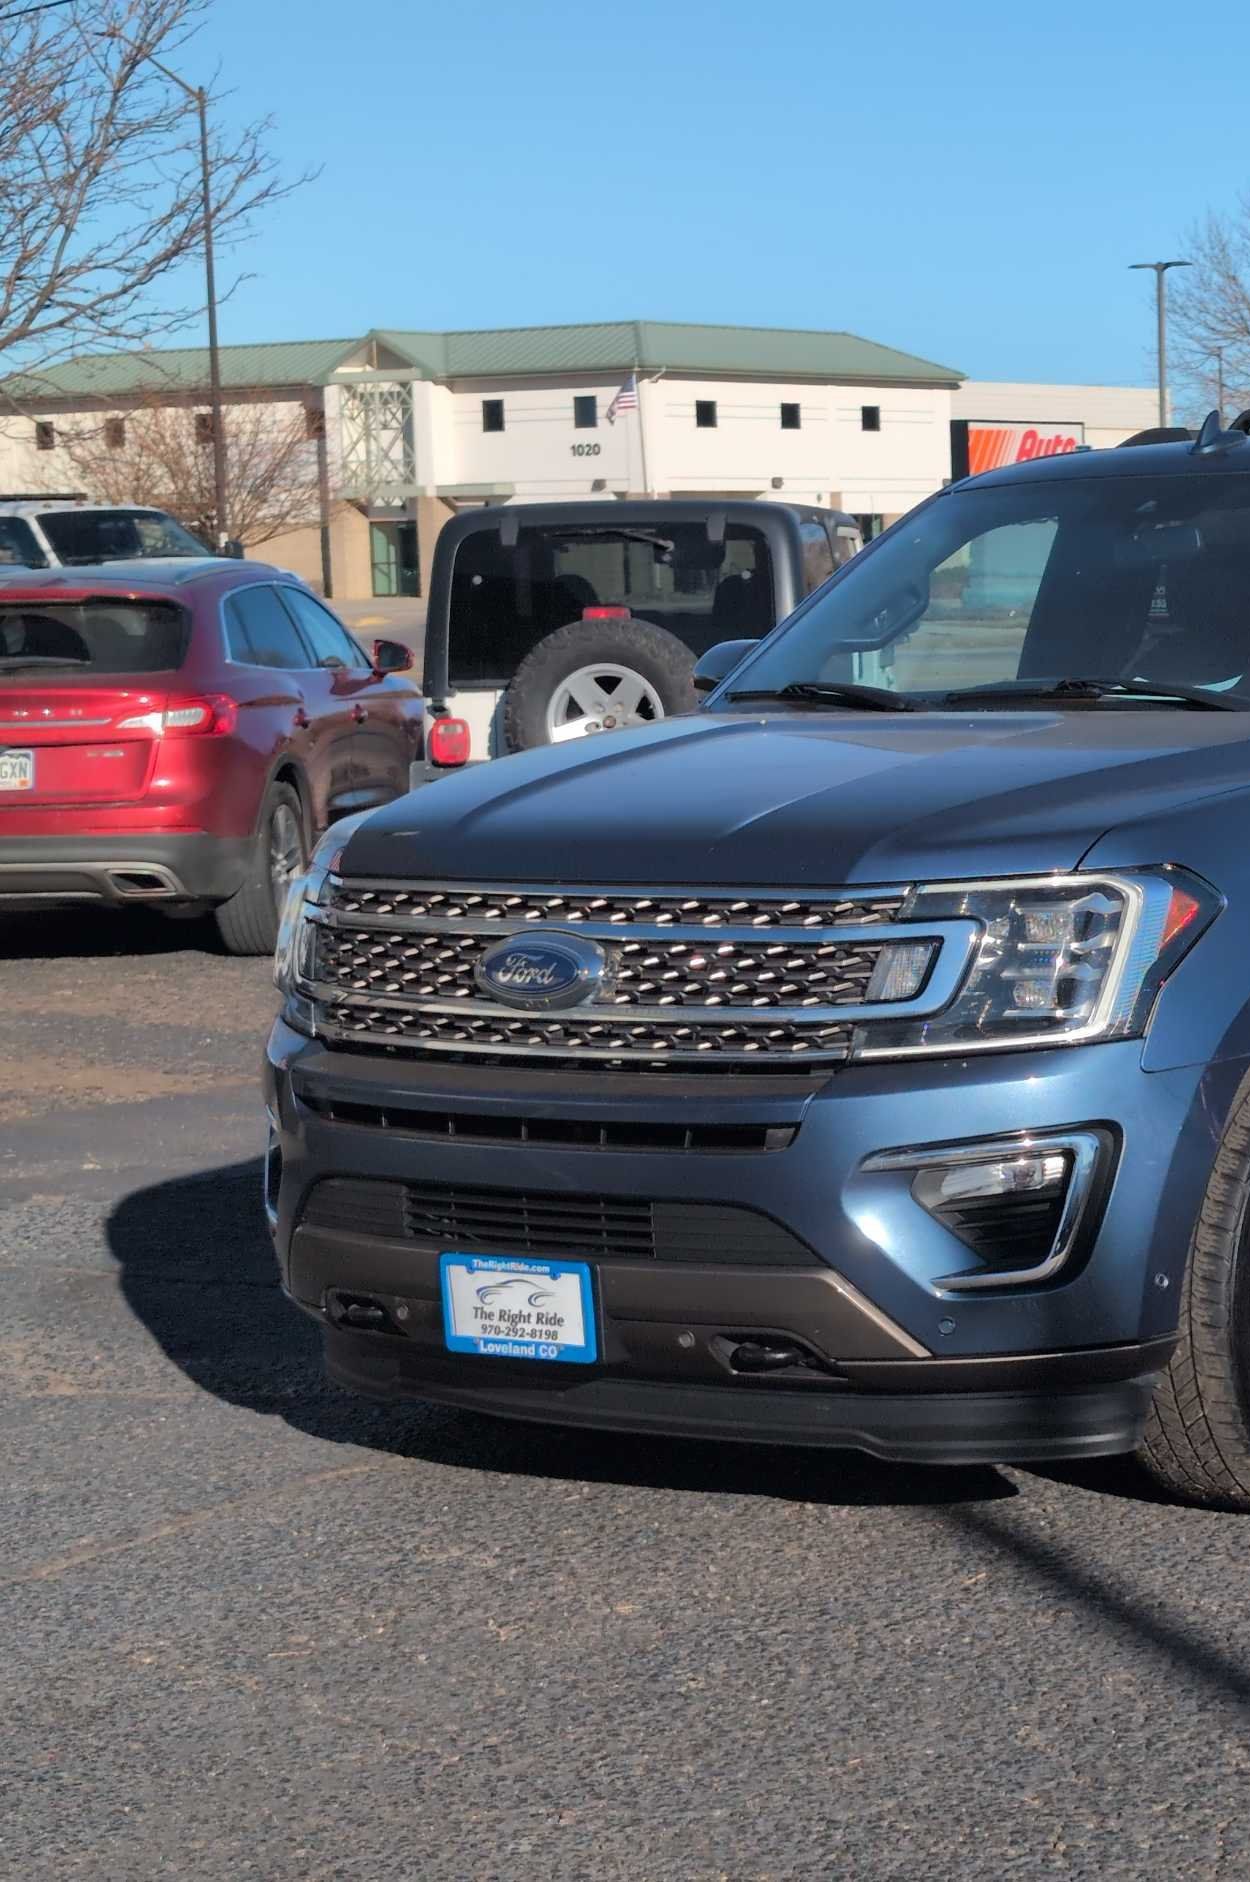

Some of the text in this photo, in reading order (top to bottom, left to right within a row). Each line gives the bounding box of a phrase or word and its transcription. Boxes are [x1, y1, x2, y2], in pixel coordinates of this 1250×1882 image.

[570, 443, 601, 457] 1020
[498, 952, 558, 984] Ford
[472, 1258, 551, 1274] TheRightRide.com
[472, 1306, 565, 1328] The Right Ride
[481, 1323, 559, 1341] 970-292-8198
[479, 1339, 558, 1359] Loveland CO
